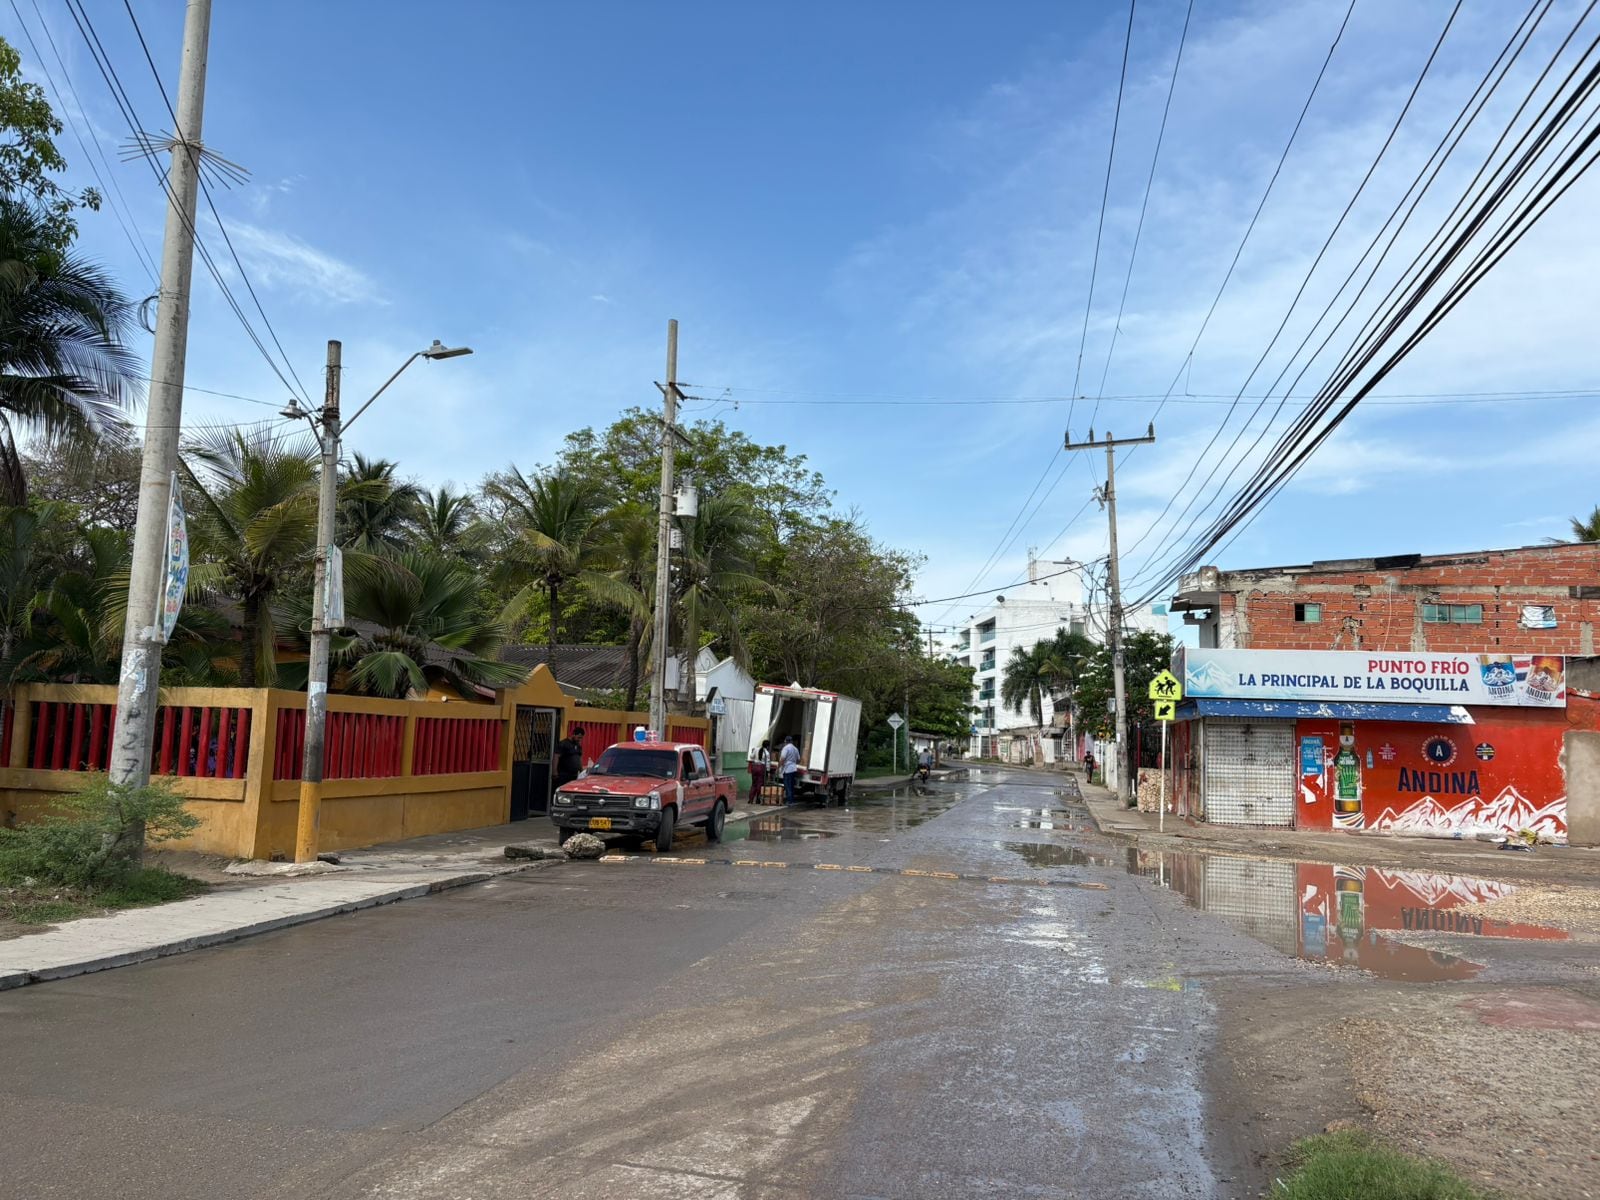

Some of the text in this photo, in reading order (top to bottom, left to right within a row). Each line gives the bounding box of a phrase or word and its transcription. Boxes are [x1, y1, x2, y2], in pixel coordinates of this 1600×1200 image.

[1367, 657, 1469, 675] PUNTO FRÍO
[1239, 673, 1470, 693] LA PRINCIPAL DE LA BOQUILLA
[1488, 685, 1514, 696] ANDINA
[1526, 686, 1552, 701] ANDINA
[1435, 745, 1443, 757] A
[1398, 766, 1480, 795] ANDINA
